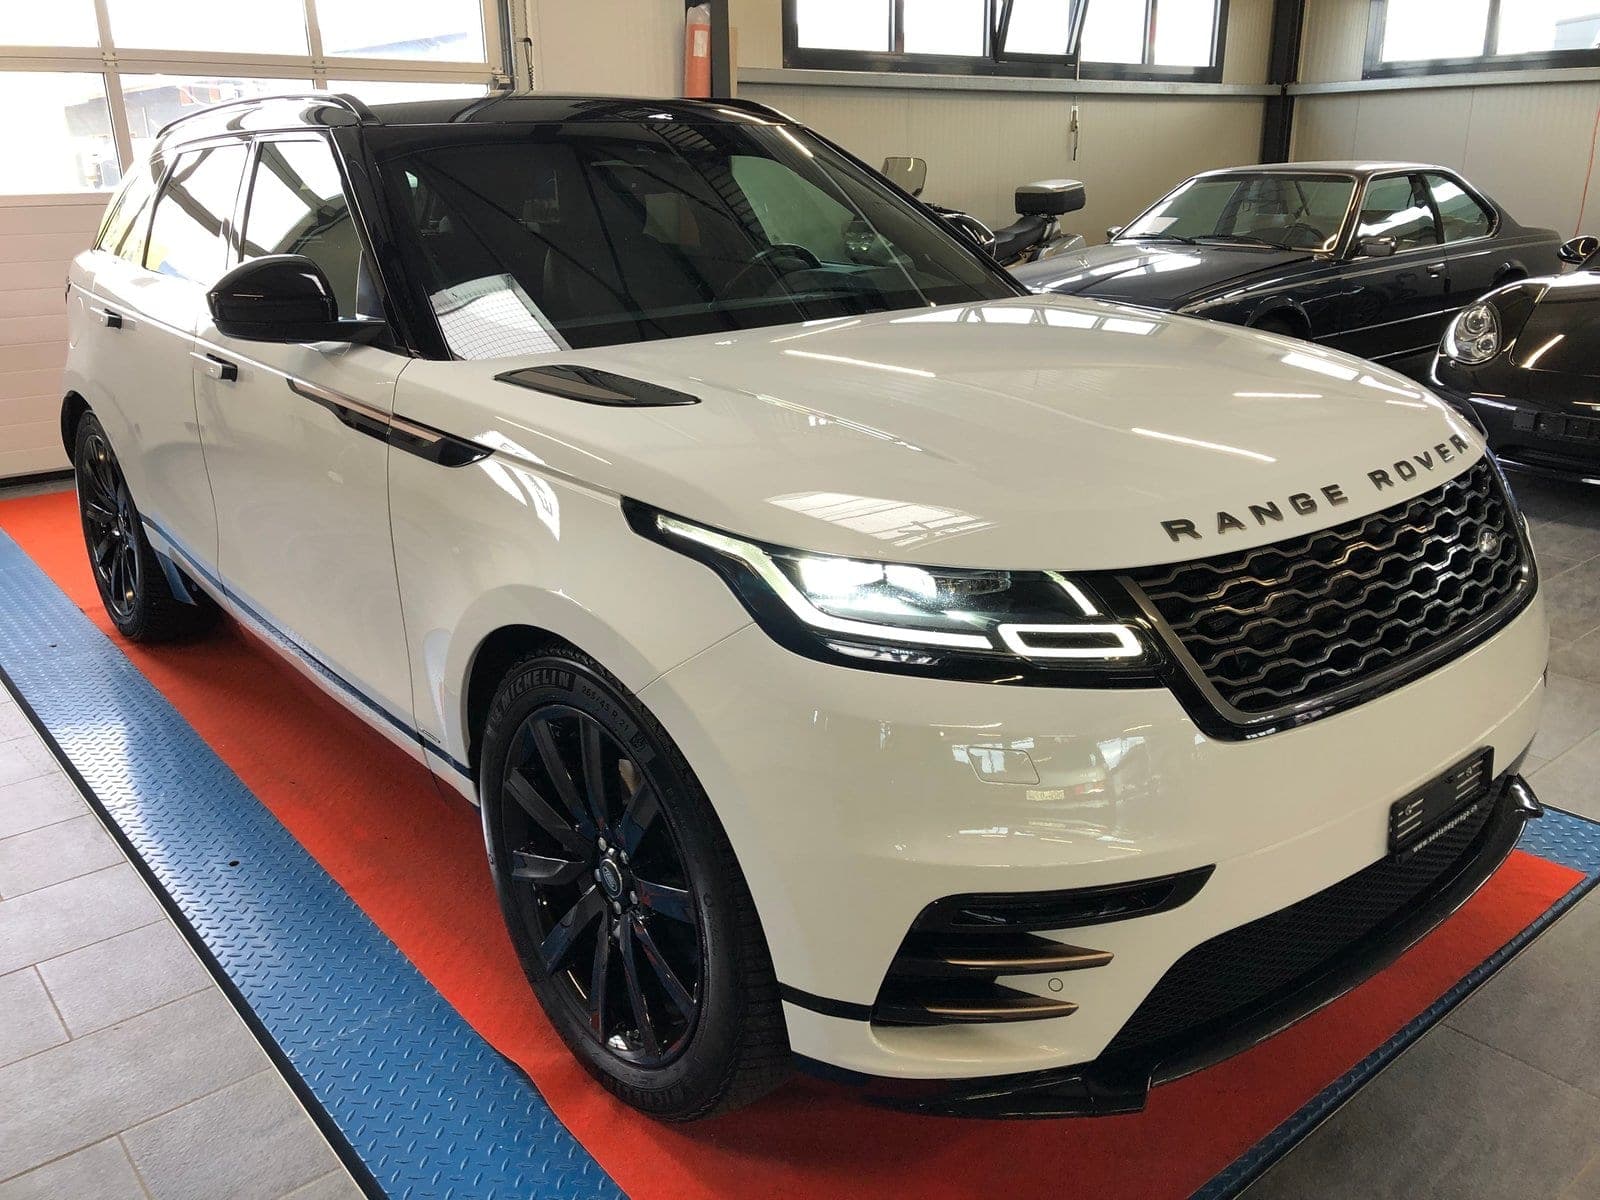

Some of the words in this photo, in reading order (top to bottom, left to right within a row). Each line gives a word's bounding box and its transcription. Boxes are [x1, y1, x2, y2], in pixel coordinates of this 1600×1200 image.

[1161, 483, 1349, 542] RANGE
[1367, 433, 1469, 491] ROVER
[502, 668, 570, 709] MICHELIN
